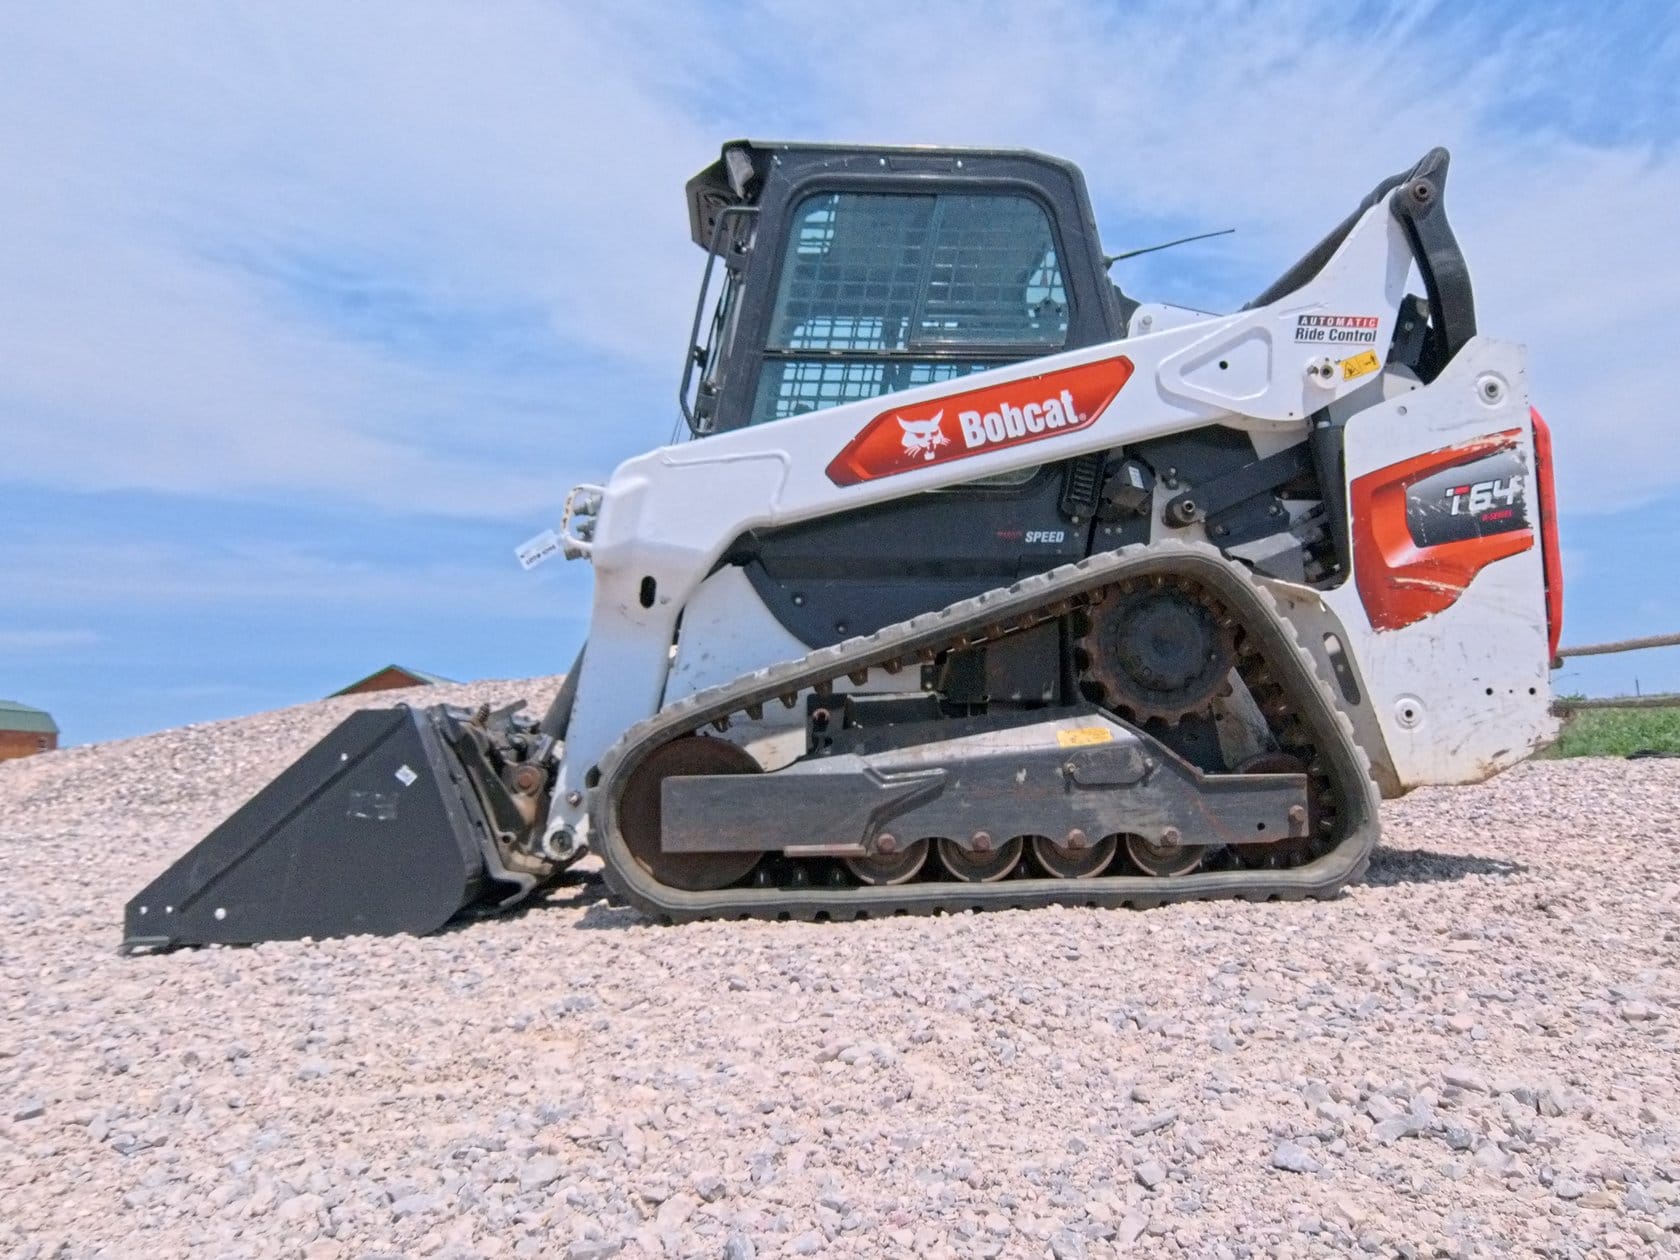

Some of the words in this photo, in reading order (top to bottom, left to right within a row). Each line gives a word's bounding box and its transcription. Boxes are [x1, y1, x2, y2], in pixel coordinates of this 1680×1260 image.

[1300, 316, 1377, 327] AUTOMATIC
[1295, 328, 1325, 340] Ride
[1329, 329, 1376, 342] Control
[958, 390, 1079, 448] Bobcat
[1445, 475, 1522, 516] T64
[1025, 531, 1064, 543] SPEED
